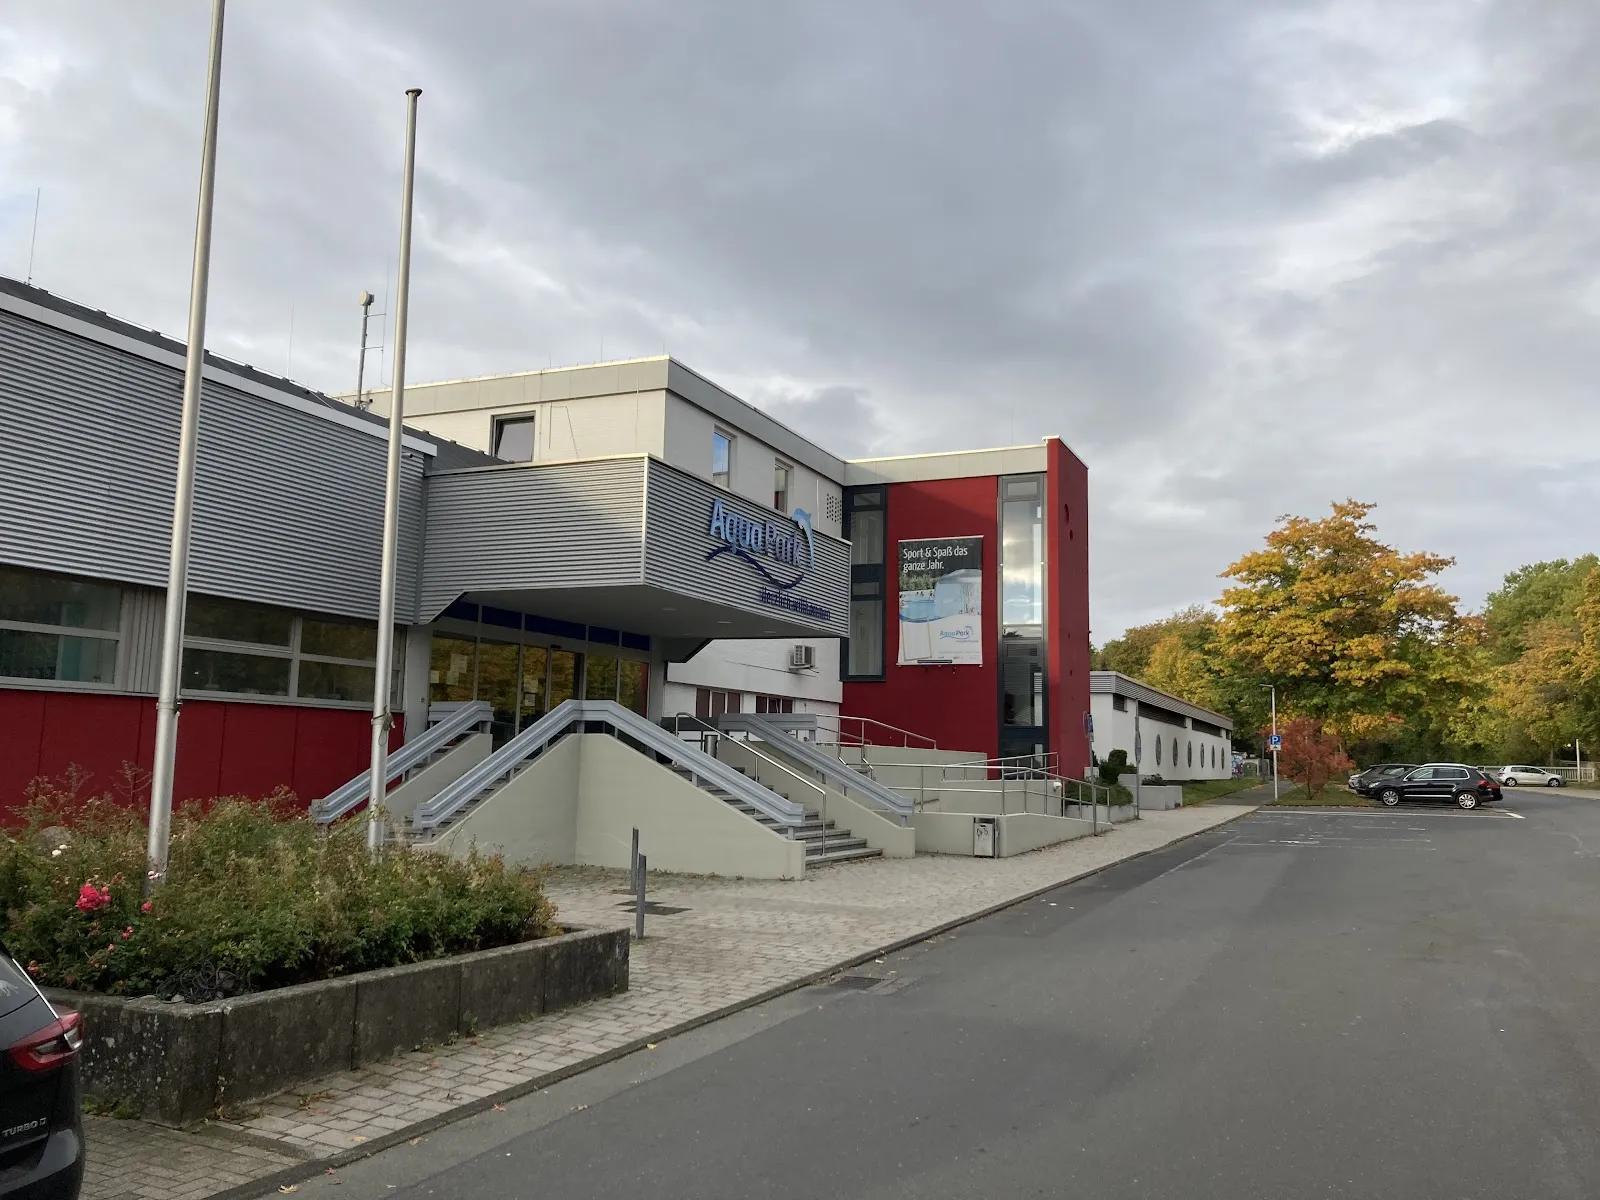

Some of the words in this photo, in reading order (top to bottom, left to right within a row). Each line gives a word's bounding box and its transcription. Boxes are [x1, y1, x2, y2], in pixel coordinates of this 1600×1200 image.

[710, 497, 802, 567] AquaPark
[903, 548, 923, 560] Sport
[925, 547, 932, 557] &
[933, 545, 953, 559] Spaß
[954, 545, 968, 556] das
[903, 563, 925, 573] ganze
[927, 559, 944, 570] Jahr.
[1272, 736, 1279, 745] P
[2, 1120, 38, 1137] TURBO
